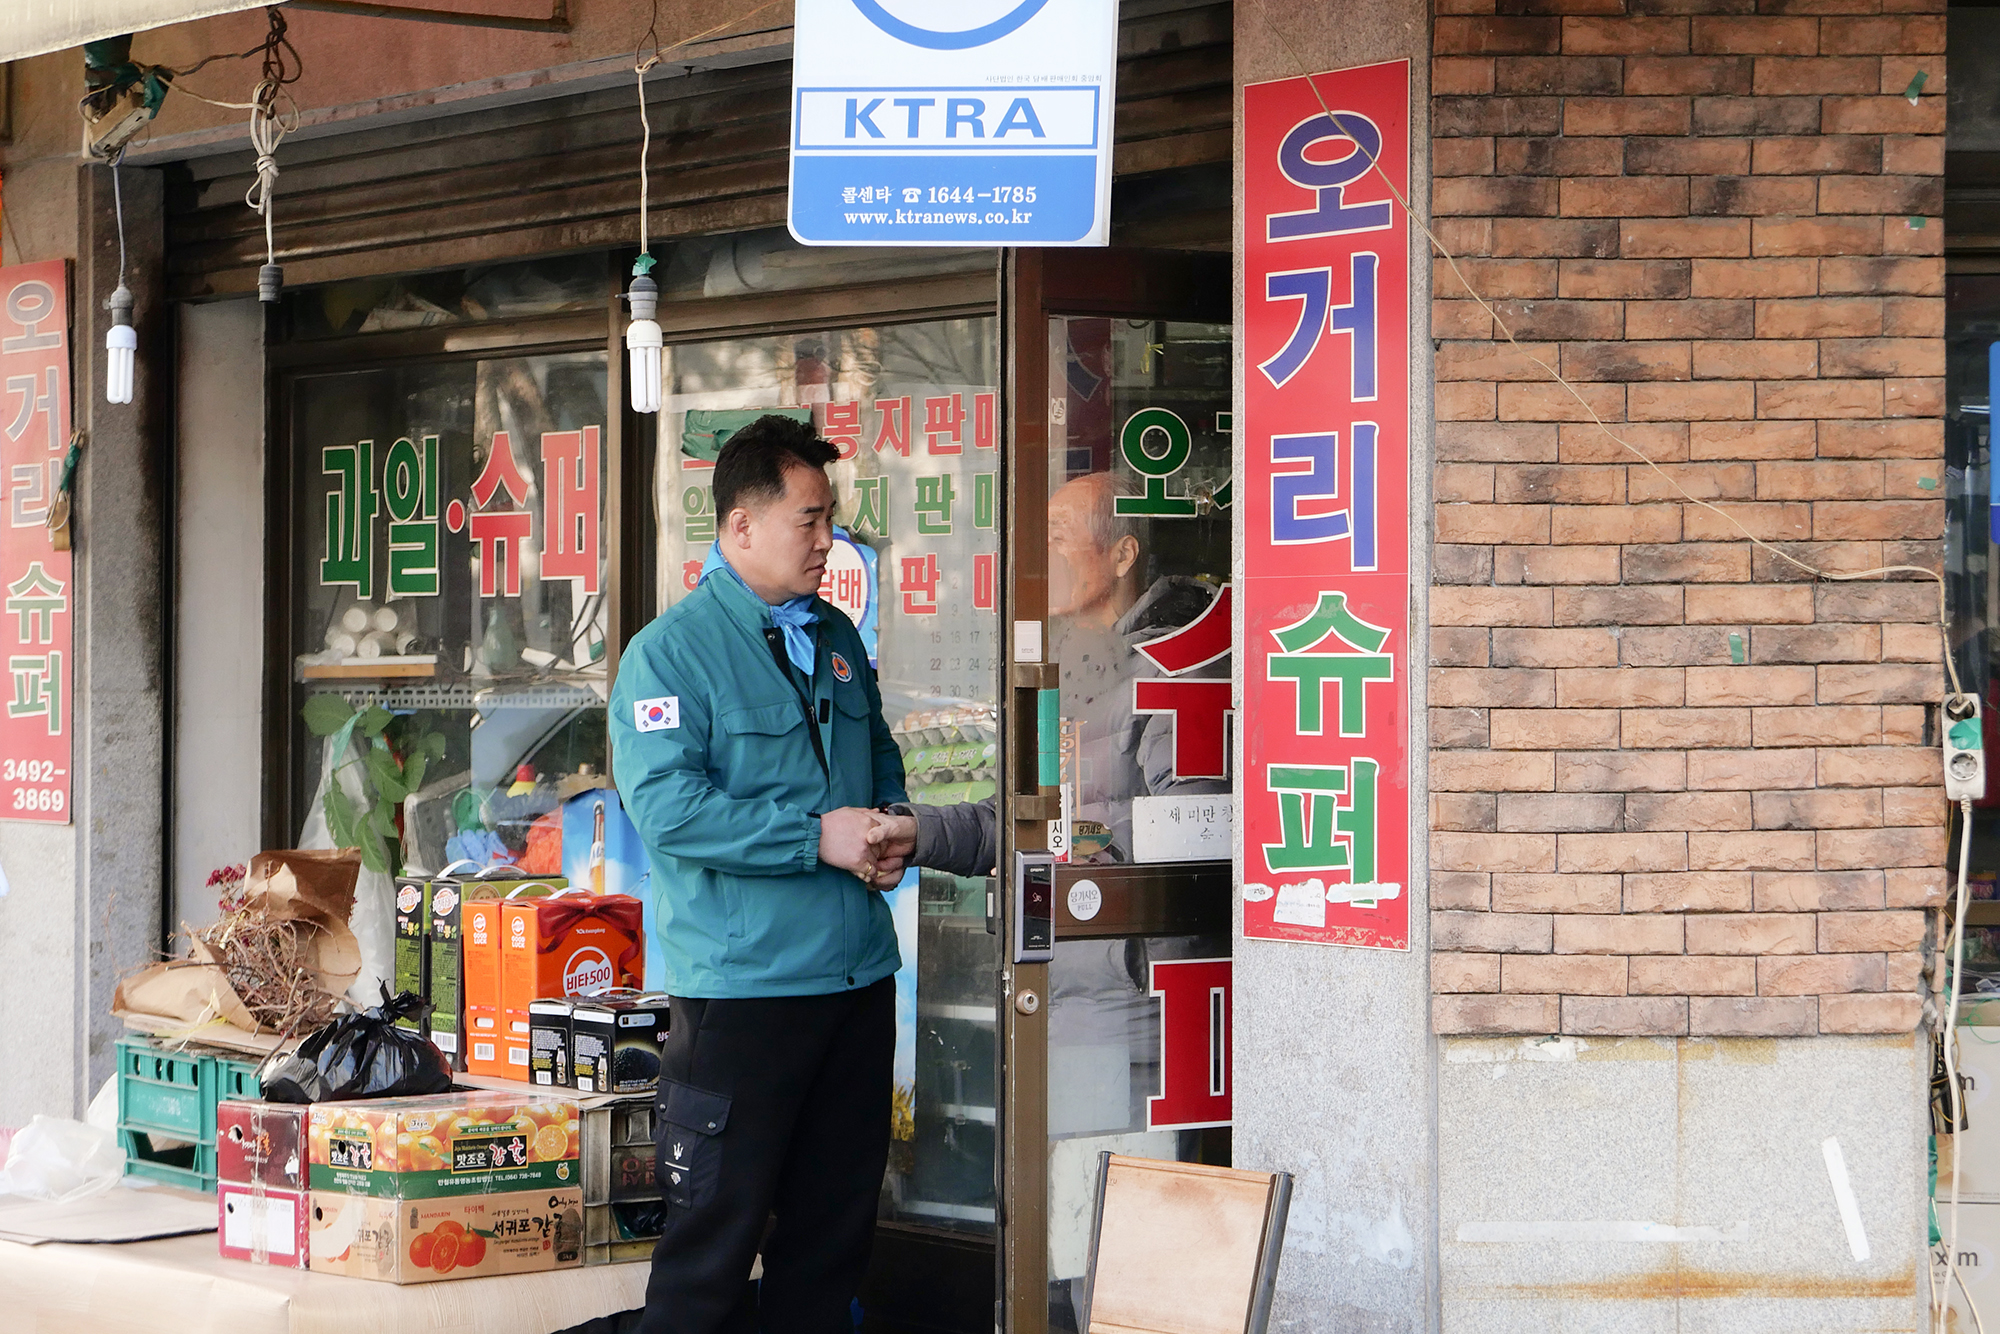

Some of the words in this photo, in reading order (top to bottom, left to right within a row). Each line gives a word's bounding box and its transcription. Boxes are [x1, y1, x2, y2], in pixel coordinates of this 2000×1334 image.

[1016, 75, 1030, 83] 한국
[1032, 75, 1048, 83] 담배
[844, 97, 1047, 139] KTRA
[841, 186, 892, 205] 콜센타
[927, 186, 1037, 204] 1644-1785
[843, 208, 1032, 225] www.ktranews.co.kr
[1257, 110, 1393, 572] 오거리
[2, 280, 62, 543] 오거리
[930, 631, 941, 644] 15
[969, 631, 980, 644] 17
[6, 561, 67, 736] 슈퍼
[930, 658, 941, 671] 22
[968, 657, 980, 671] 24
[930, 685, 941, 698] 29
[950, 684, 961, 698] 30
[968, 684, 979, 698] 31
[1261, 590, 1394, 909] 슈퍼
[3, 758, 67, 783] 3492-
[12, 787, 65, 813] 3869
[1169, 805, 1180, 824] 세
[1188, 805, 1215, 823] 미만
[1078, 824, 1102, 835] 당기세요
[1070, 889, 1099, 903] 당기시오
[1077, 903, 1093, 911] PULL
[566, 966, 611, 991] 비타500
[456, 1152, 486, 1167] 맛조은
[420, 1211, 451, 1220] MANDARIN
[492, 1218, 531, 1237] 서귀포
